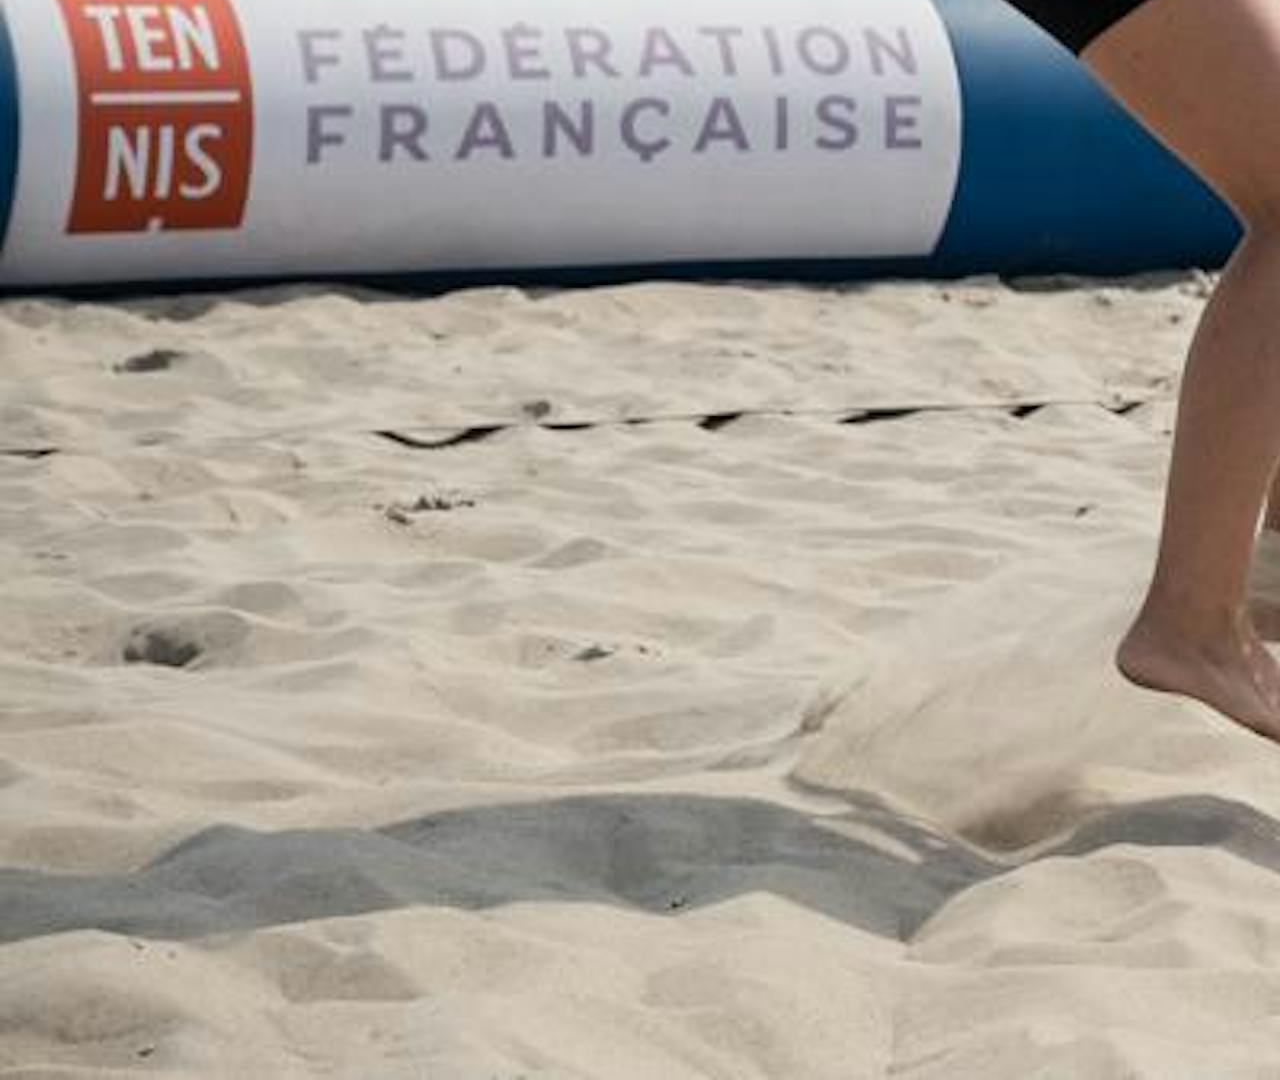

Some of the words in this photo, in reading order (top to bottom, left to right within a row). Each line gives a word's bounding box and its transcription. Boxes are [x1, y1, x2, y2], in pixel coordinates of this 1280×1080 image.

[84, 3, 219, 72] TEN
[298, 21, 918, 84] FÉDÉRATION
[104, 125, 223, 201] NIS
[305, 96, 923, 165] FRANÇAISE
